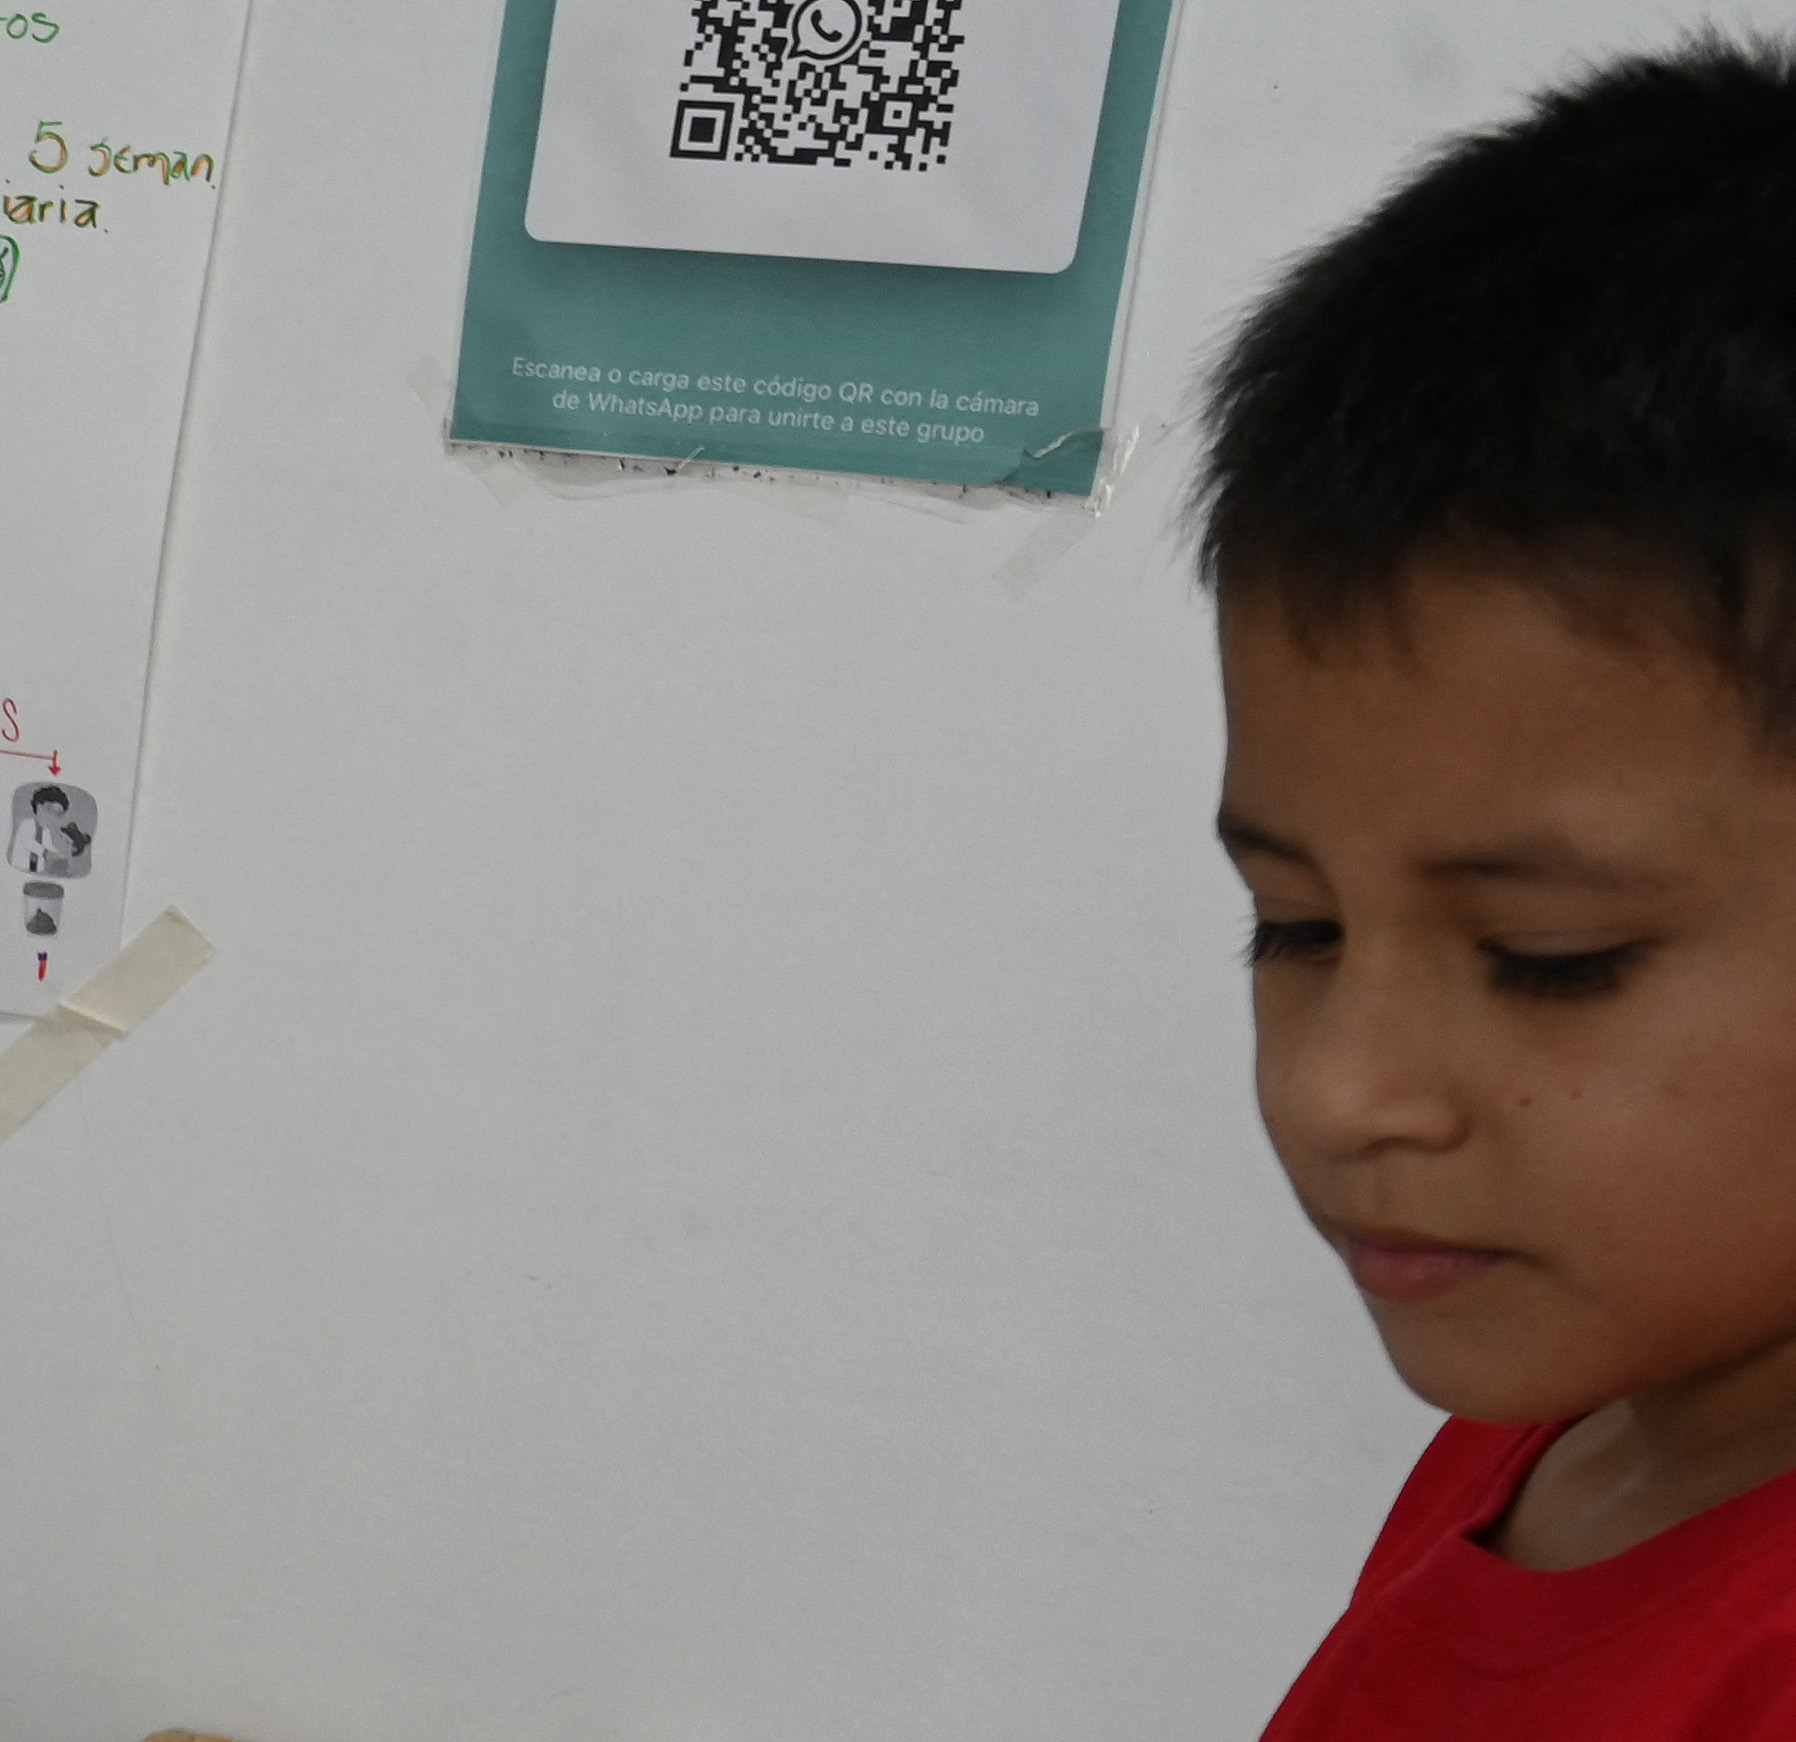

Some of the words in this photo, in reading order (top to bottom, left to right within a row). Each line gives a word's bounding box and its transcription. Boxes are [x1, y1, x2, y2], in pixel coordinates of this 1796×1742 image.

[28, 120, 69, 174] 5
[511, 355, 602, 383] Escanea
[607, 367, 623, 385] o
[627, 368, 691, 393] carga
[696, 372, 747, 394] este
[752, 373, 833, 403] código
[838, 380, 875, 405] QR
[880, 387, 923, 409] con
[929, 388, 949, 411] la
[955, 390, 1040, 418] cámara
[551, 389, 581, 411] de
[587, 391, 704, 424] WhatsApp
[709, 404, 762, 425] para
[767, 406, 836, 432] unirte
[840, 415, 855, 433] a
[860, 415, 911, 438] este
[916, 421, 986, 446] grupo
